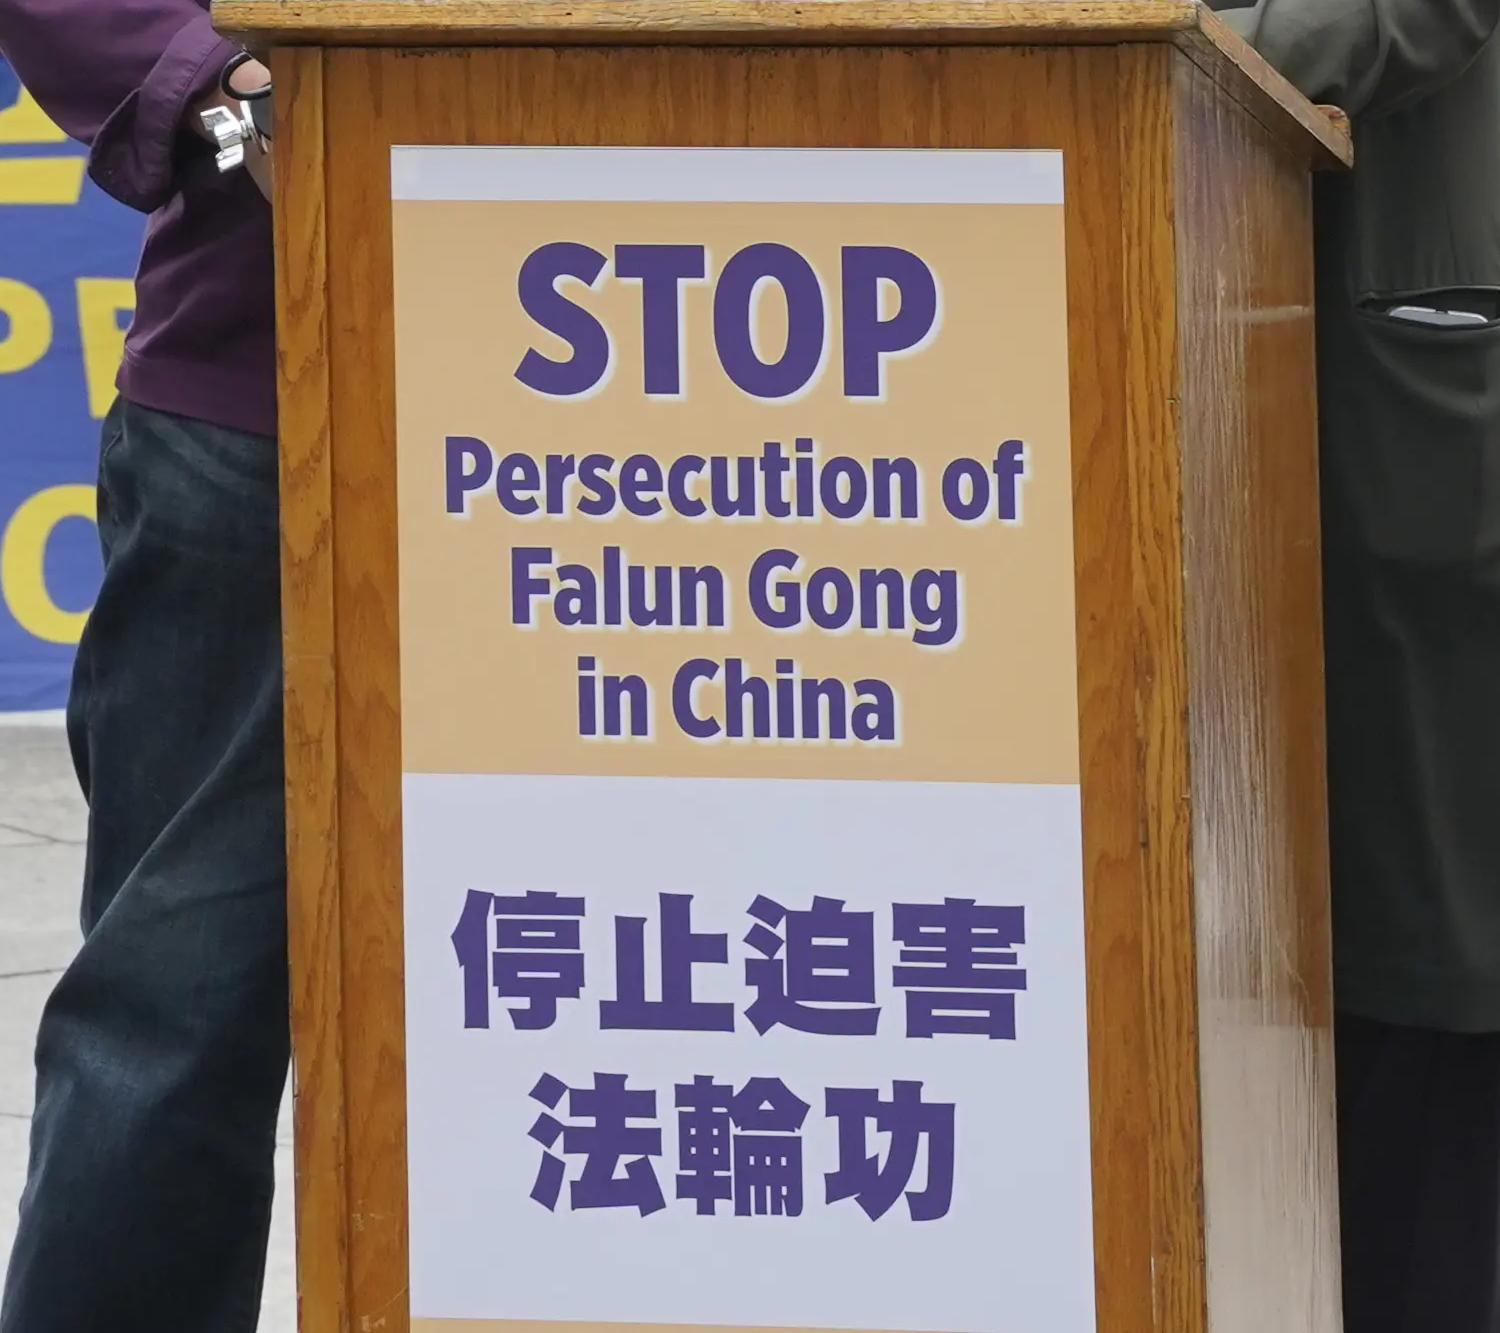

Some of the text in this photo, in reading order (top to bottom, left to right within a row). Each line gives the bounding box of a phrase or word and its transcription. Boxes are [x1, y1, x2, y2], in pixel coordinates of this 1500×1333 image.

[515, 241, 939, 399] STOP
[445, 435, 1025, 521] Persecution of
[510, 546, 960, 647] Falun Gong
[577, 655, 897, 742] in China
[449, 887, 1029, 1042] 停止迫害
[527, 1070, 957, 1224] 法輪功
